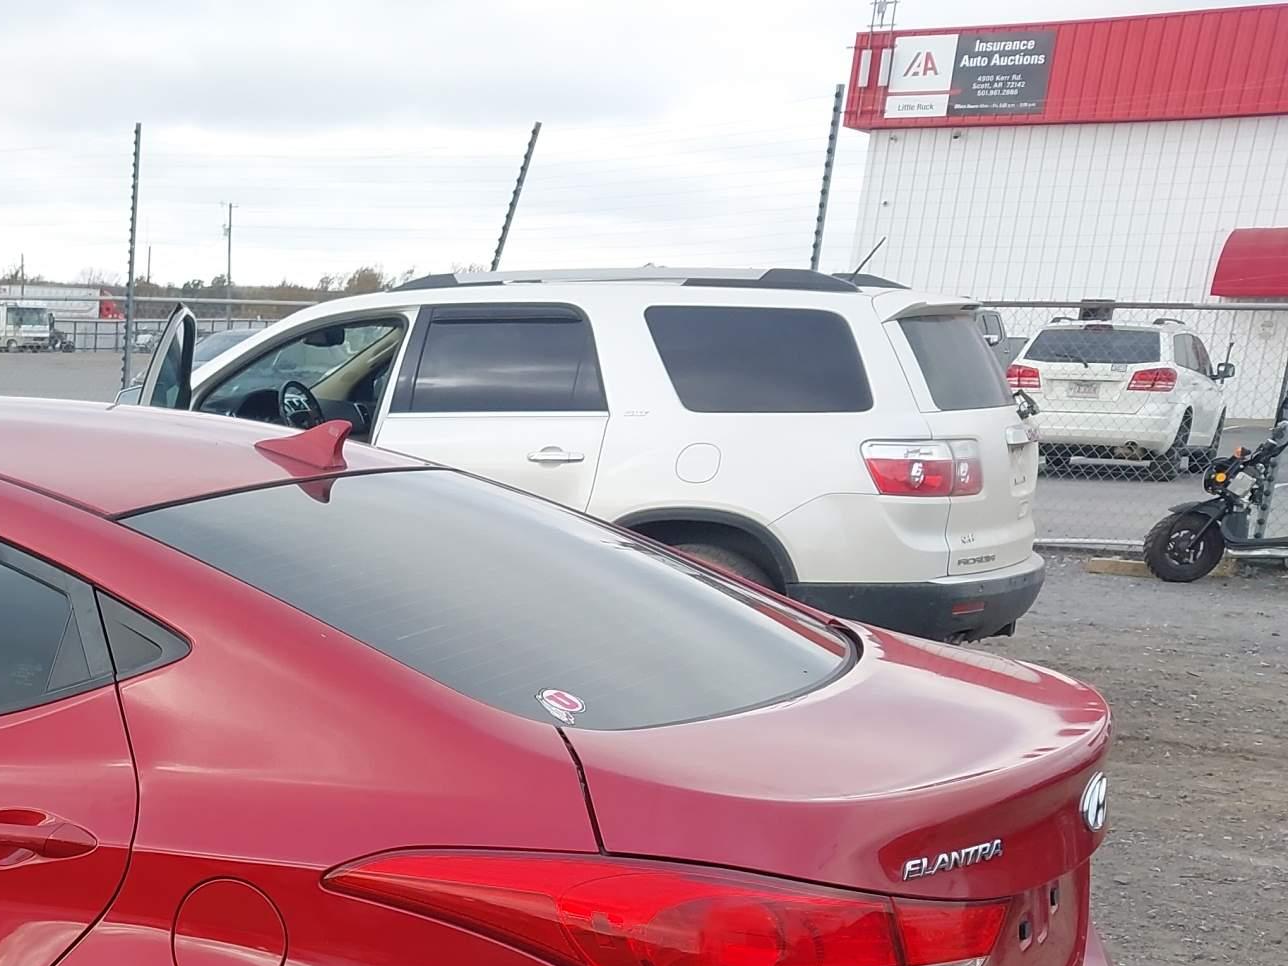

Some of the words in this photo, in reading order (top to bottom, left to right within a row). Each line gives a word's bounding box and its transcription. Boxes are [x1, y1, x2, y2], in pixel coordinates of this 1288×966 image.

[975, 39, 1036, 52] Insurance
[960, 54, 988, 67] Auto
[990, 52, 1046, 66] Auctions
[897, 103, 916, 112] Little
[902, 838, 1004, 881] ELANTRA
